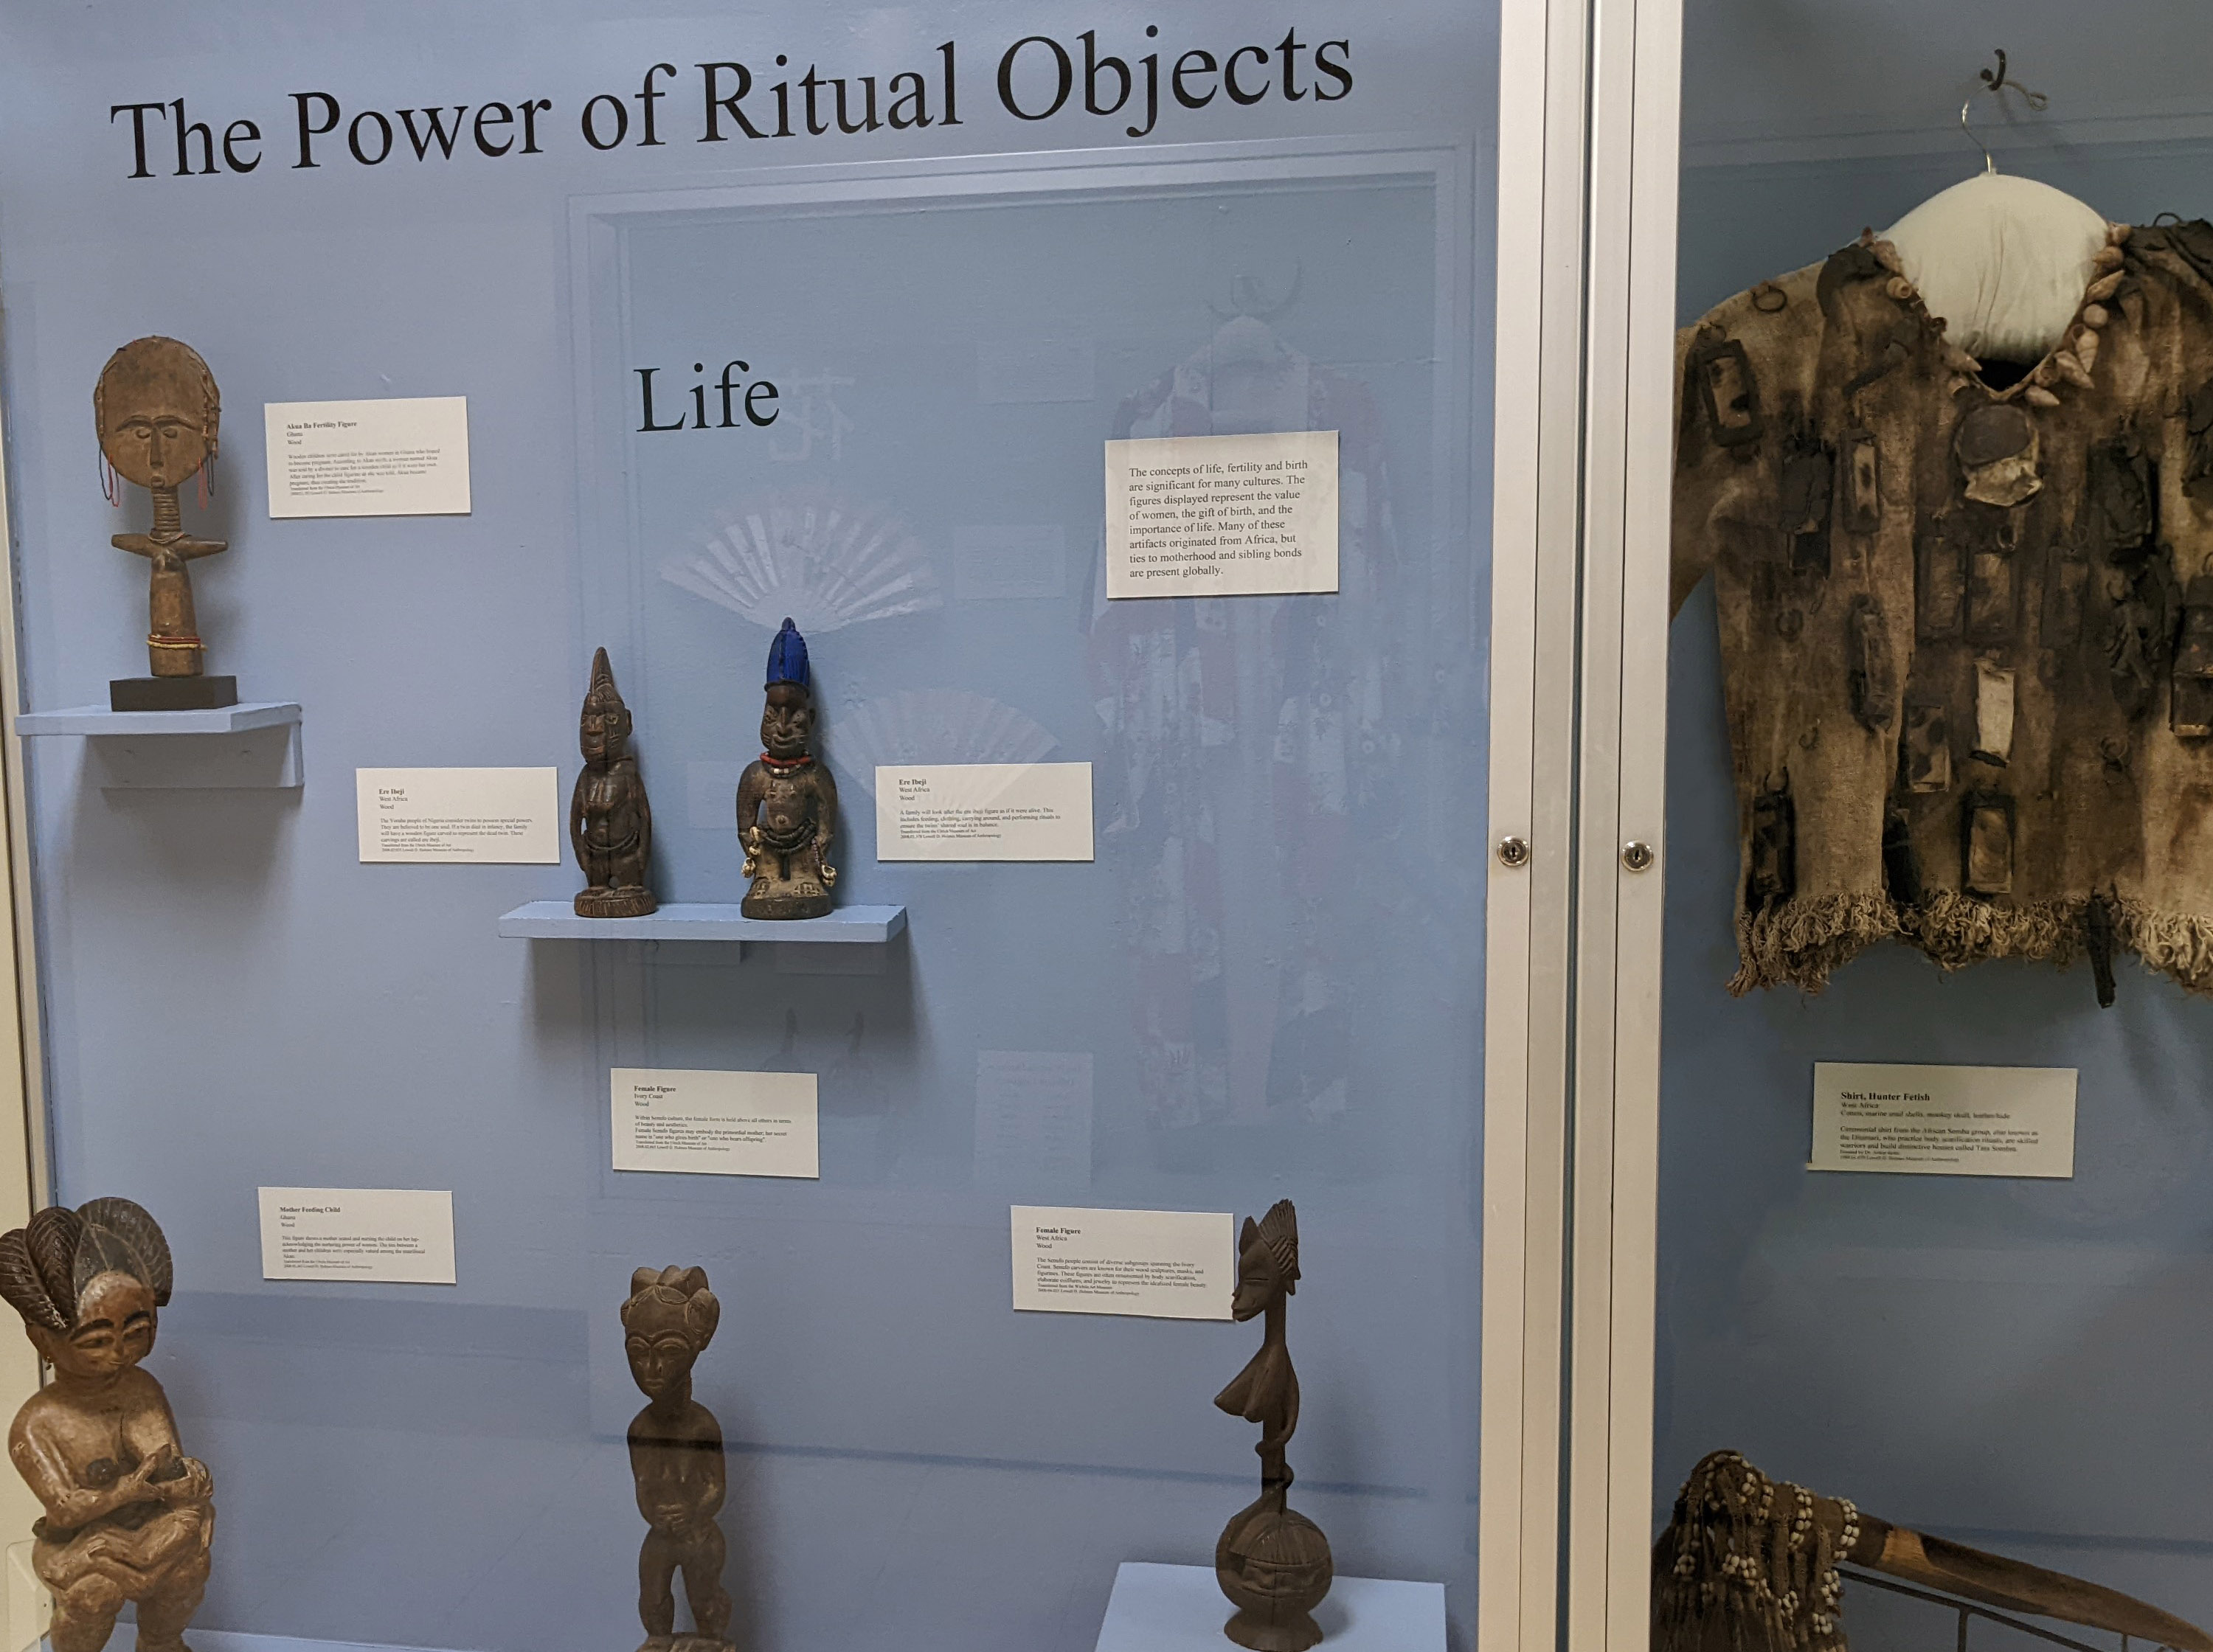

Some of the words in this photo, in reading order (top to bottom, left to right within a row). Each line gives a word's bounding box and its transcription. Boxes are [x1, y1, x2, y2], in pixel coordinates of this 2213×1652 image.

[111, 98, 261, 178] The
[288, 92, 551, 168] Power
[582, 63, 676, 150] of
[695, 41, 963, 142] Ritual
[998, 25, 1352, 137] Objects
[634, 361, 779, 431] Life
[313, 422, 336, 430] Fertility
[1129, 467, 1146, 476] The
[1149, 466, 1190, 478] concepts
[1192, 465, 1204, 474] of
[1205, 464, 1224, 475] life,
[1227, 462, 1262, 475] fertility
[1264, 461, 1282, 471] and
[1285, 460, 1308, 470] birth
[1146, 479, 1194, 493] significant
[1197, 479, 1211, 488] for
[1213, 481, 1240, 490] many
[1242, 476, 1283, 487] cultures.
[1286, 475, 1305, 485] The
[1129, 495, 1161, 507] figures
[1163, 493, 1208, 506] displayed
[1211, 493, 1254, 504] represent
[1256, 491, 1272, 500] the
[1274, 490, 1301, 499] value
[1129, 510, 1140, 520] of
[1141, 512, 1178, 521] women,
[1181, 508, 1196, 518] the
[1198, 507, 1214, 519] gift
[1217, 507, 1228, 516] of
[1230, 506, 1255, 517] birth,
[1258, 505, 1275, 515] and
[1278, 504, 1293, 514] the
[1129, 524, 1181, 537] importance
[1183, 523, 1195, 532] of
[1196, 522, 1214, 532] life.
[1217, 521, 1244, 533] Many
[1247, 521, 1259, 530] of
[1261, 519, 1285, 530] these
[1129, 538, 1166, 549] artifacts
[1168, 536, 1216, 549] originated
[1219, 535, 1241, 545] from
[1244, 534, 1278, 546] Africa,
[1281, 533, 1296, 543] but
[1129, 555, 1146, 563] ties
[1148, 555, 1157, 563] to
[1160, 551, 1216, 562] motherhood
[1218, 550, 1236, 560] and
[1238, 549, 1270, 561] sibling
[1273, 548, 1302, 558] bonds
[1146, 569, 1179, 580] present
[1182, 566, 1224, 578] globally.
[912, 779, 927, 787] Ibeji
[1841, 1091, 1866, 1101] Shirt,
[1869, 1092, 1899, 1100] Hunter
[1903, 1092, 1930, 1101] Fetish
[1060, 1227, 1081, 1235] Figure
